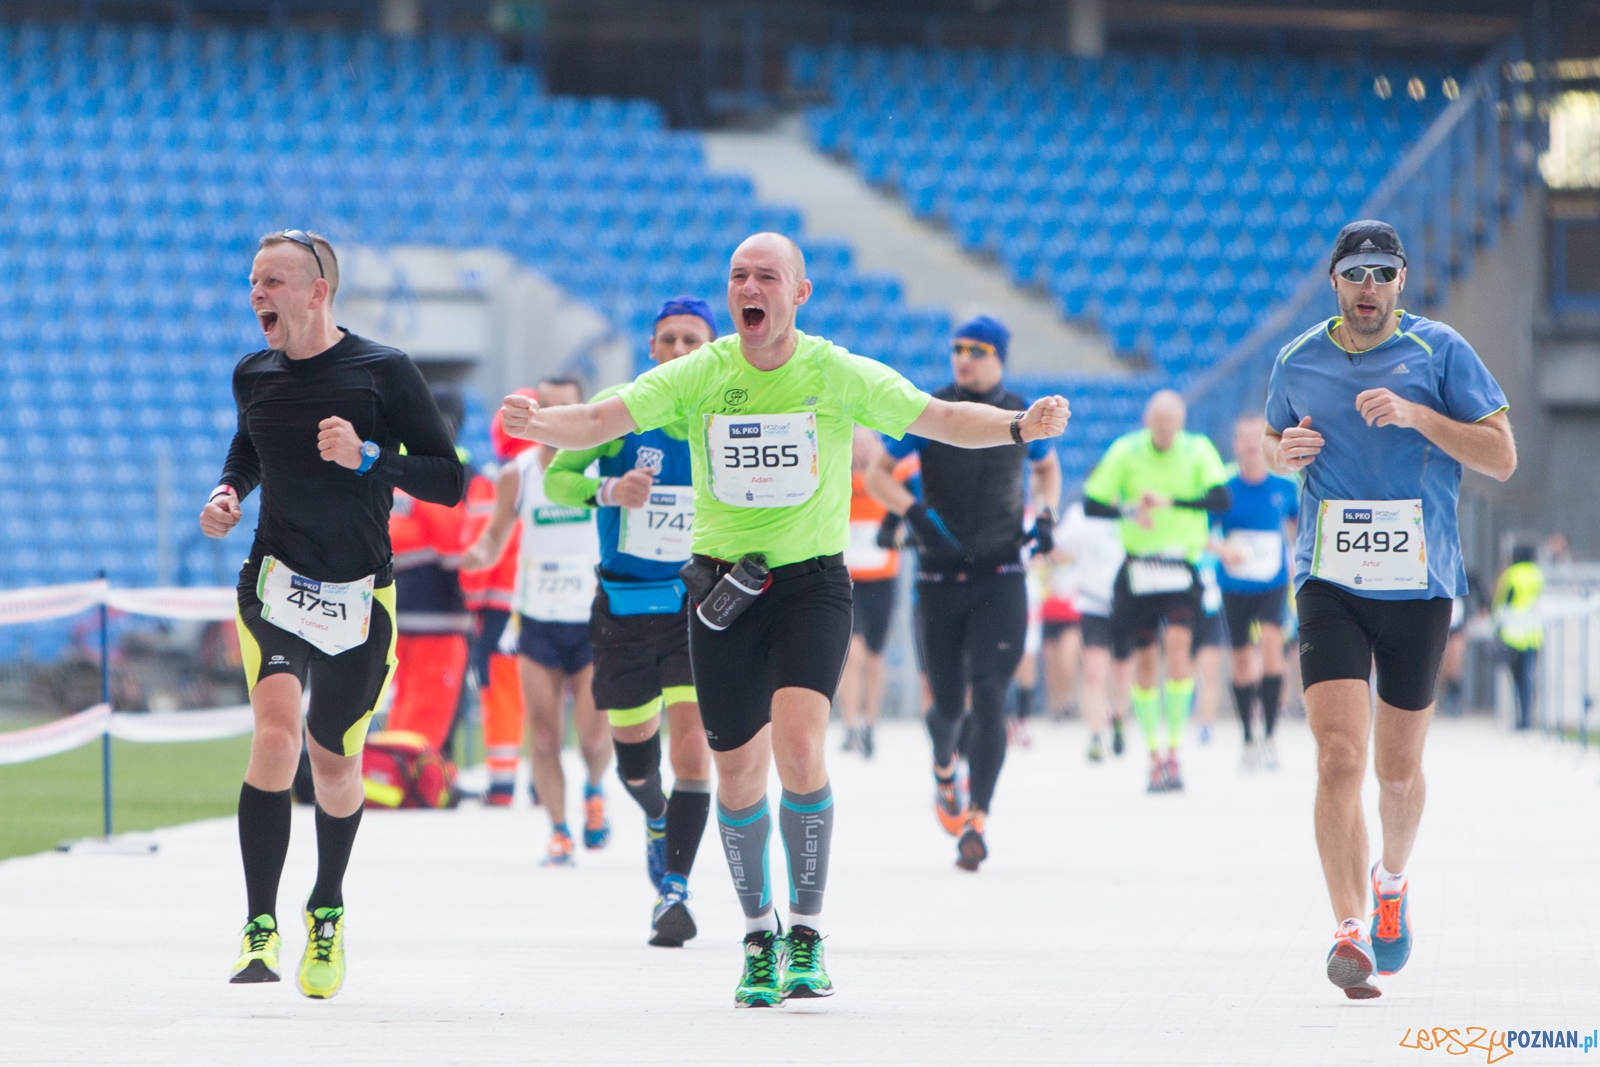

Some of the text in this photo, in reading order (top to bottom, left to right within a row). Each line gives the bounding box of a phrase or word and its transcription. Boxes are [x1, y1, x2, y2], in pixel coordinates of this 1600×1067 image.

[723, 445, 799, 468] 3365
[1336, 531, 1409, 553] 6492
[286, 590, 347, 621] 4751
[300, 617, 329, 631] Tomasz
